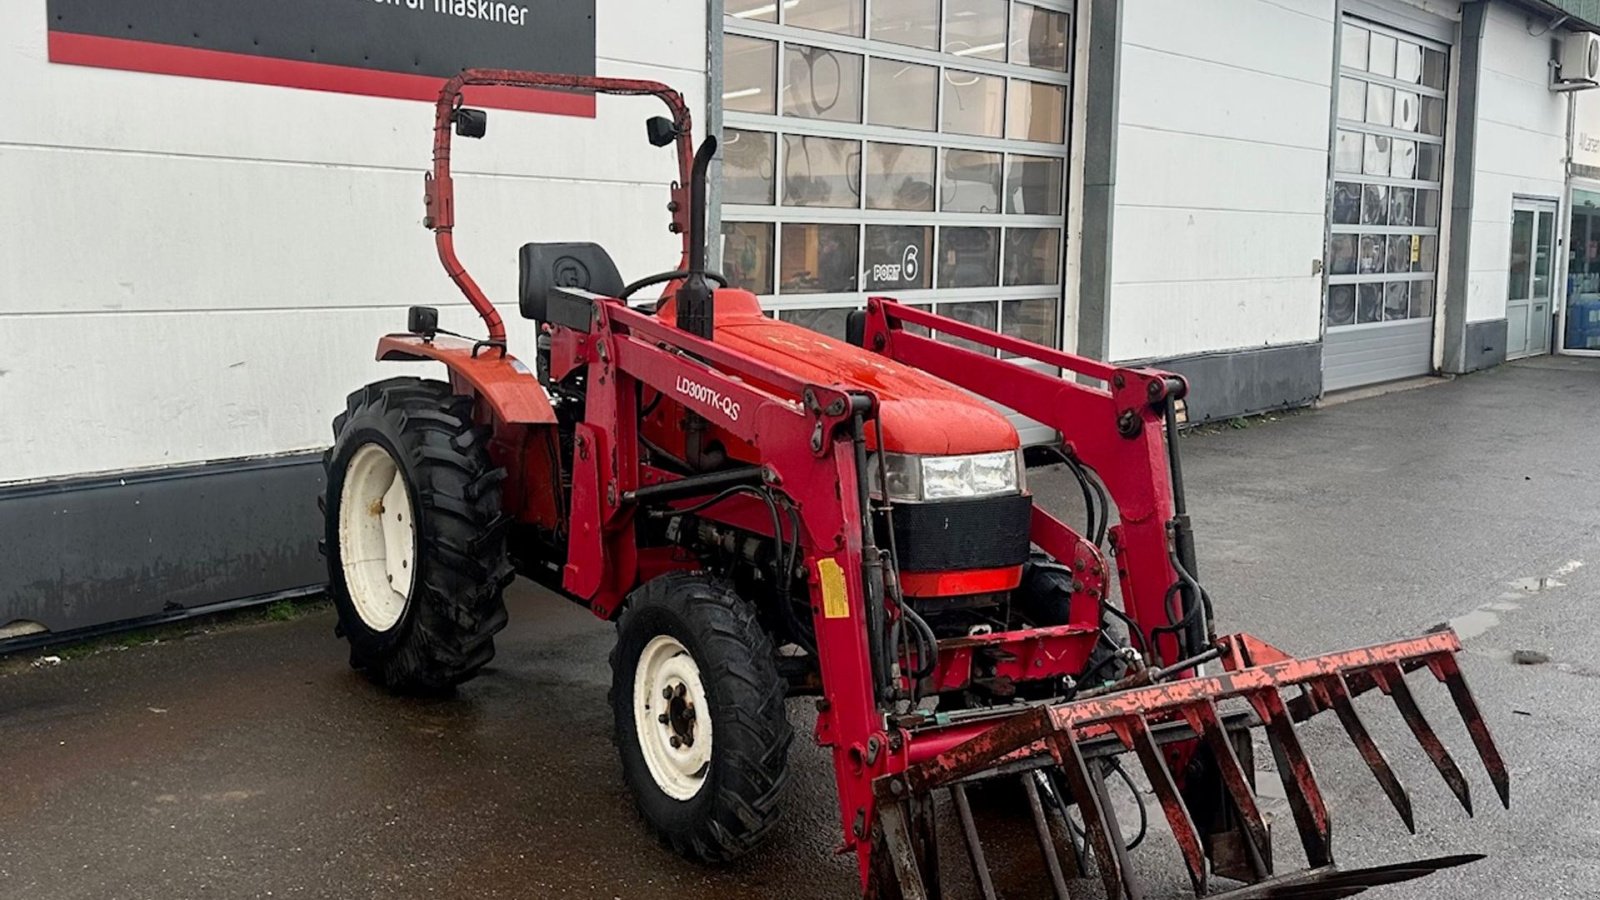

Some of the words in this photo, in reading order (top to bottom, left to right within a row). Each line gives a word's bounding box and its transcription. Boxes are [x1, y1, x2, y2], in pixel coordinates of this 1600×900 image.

[434, 0, 528, 26] maskiner
[873, 264, 901, 281] PORT
[902, 244, 918, 281] 6
[676, 375, 740, 421] LD300TK-QS
